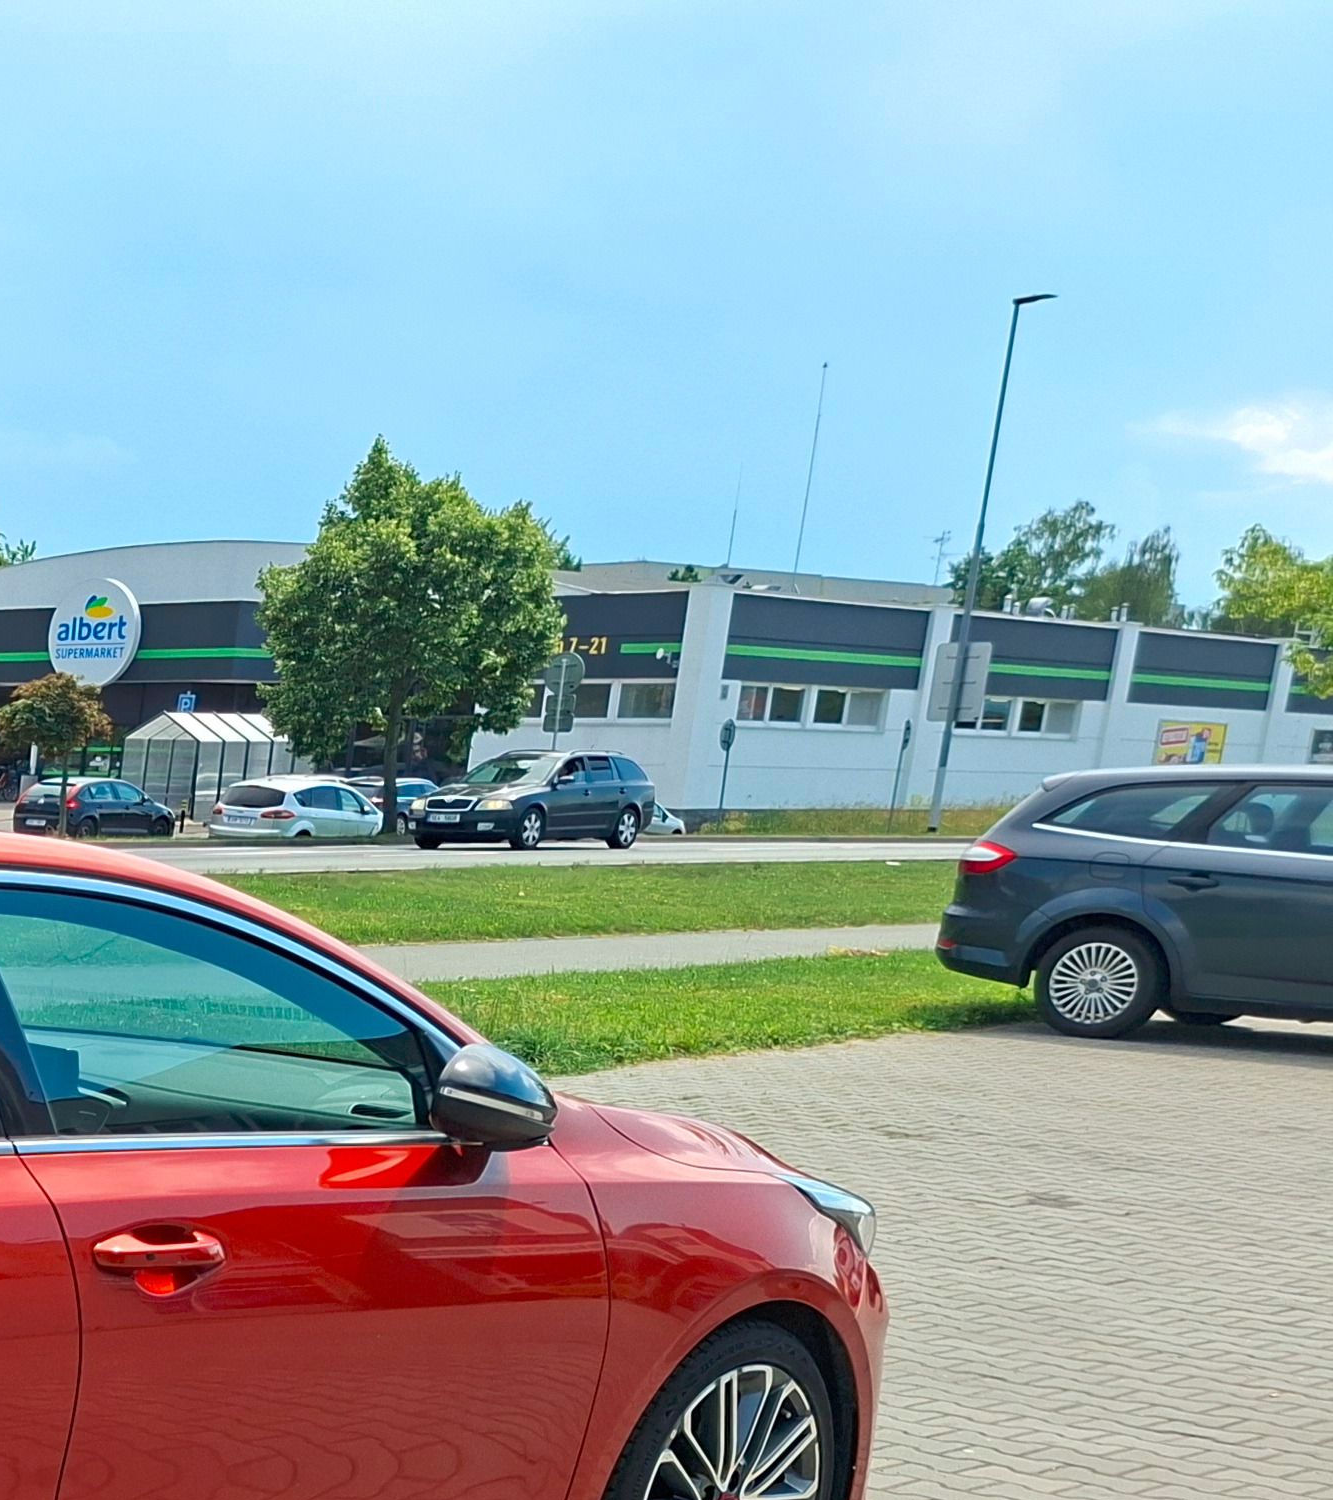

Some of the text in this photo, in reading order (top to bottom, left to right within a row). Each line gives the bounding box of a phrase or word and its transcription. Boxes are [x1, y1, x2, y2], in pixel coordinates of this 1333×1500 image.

[57, 615, 127, 641] albert
[55, 646, 125, 659] SUPERMARKET
[181, 698, 190, 712] P
